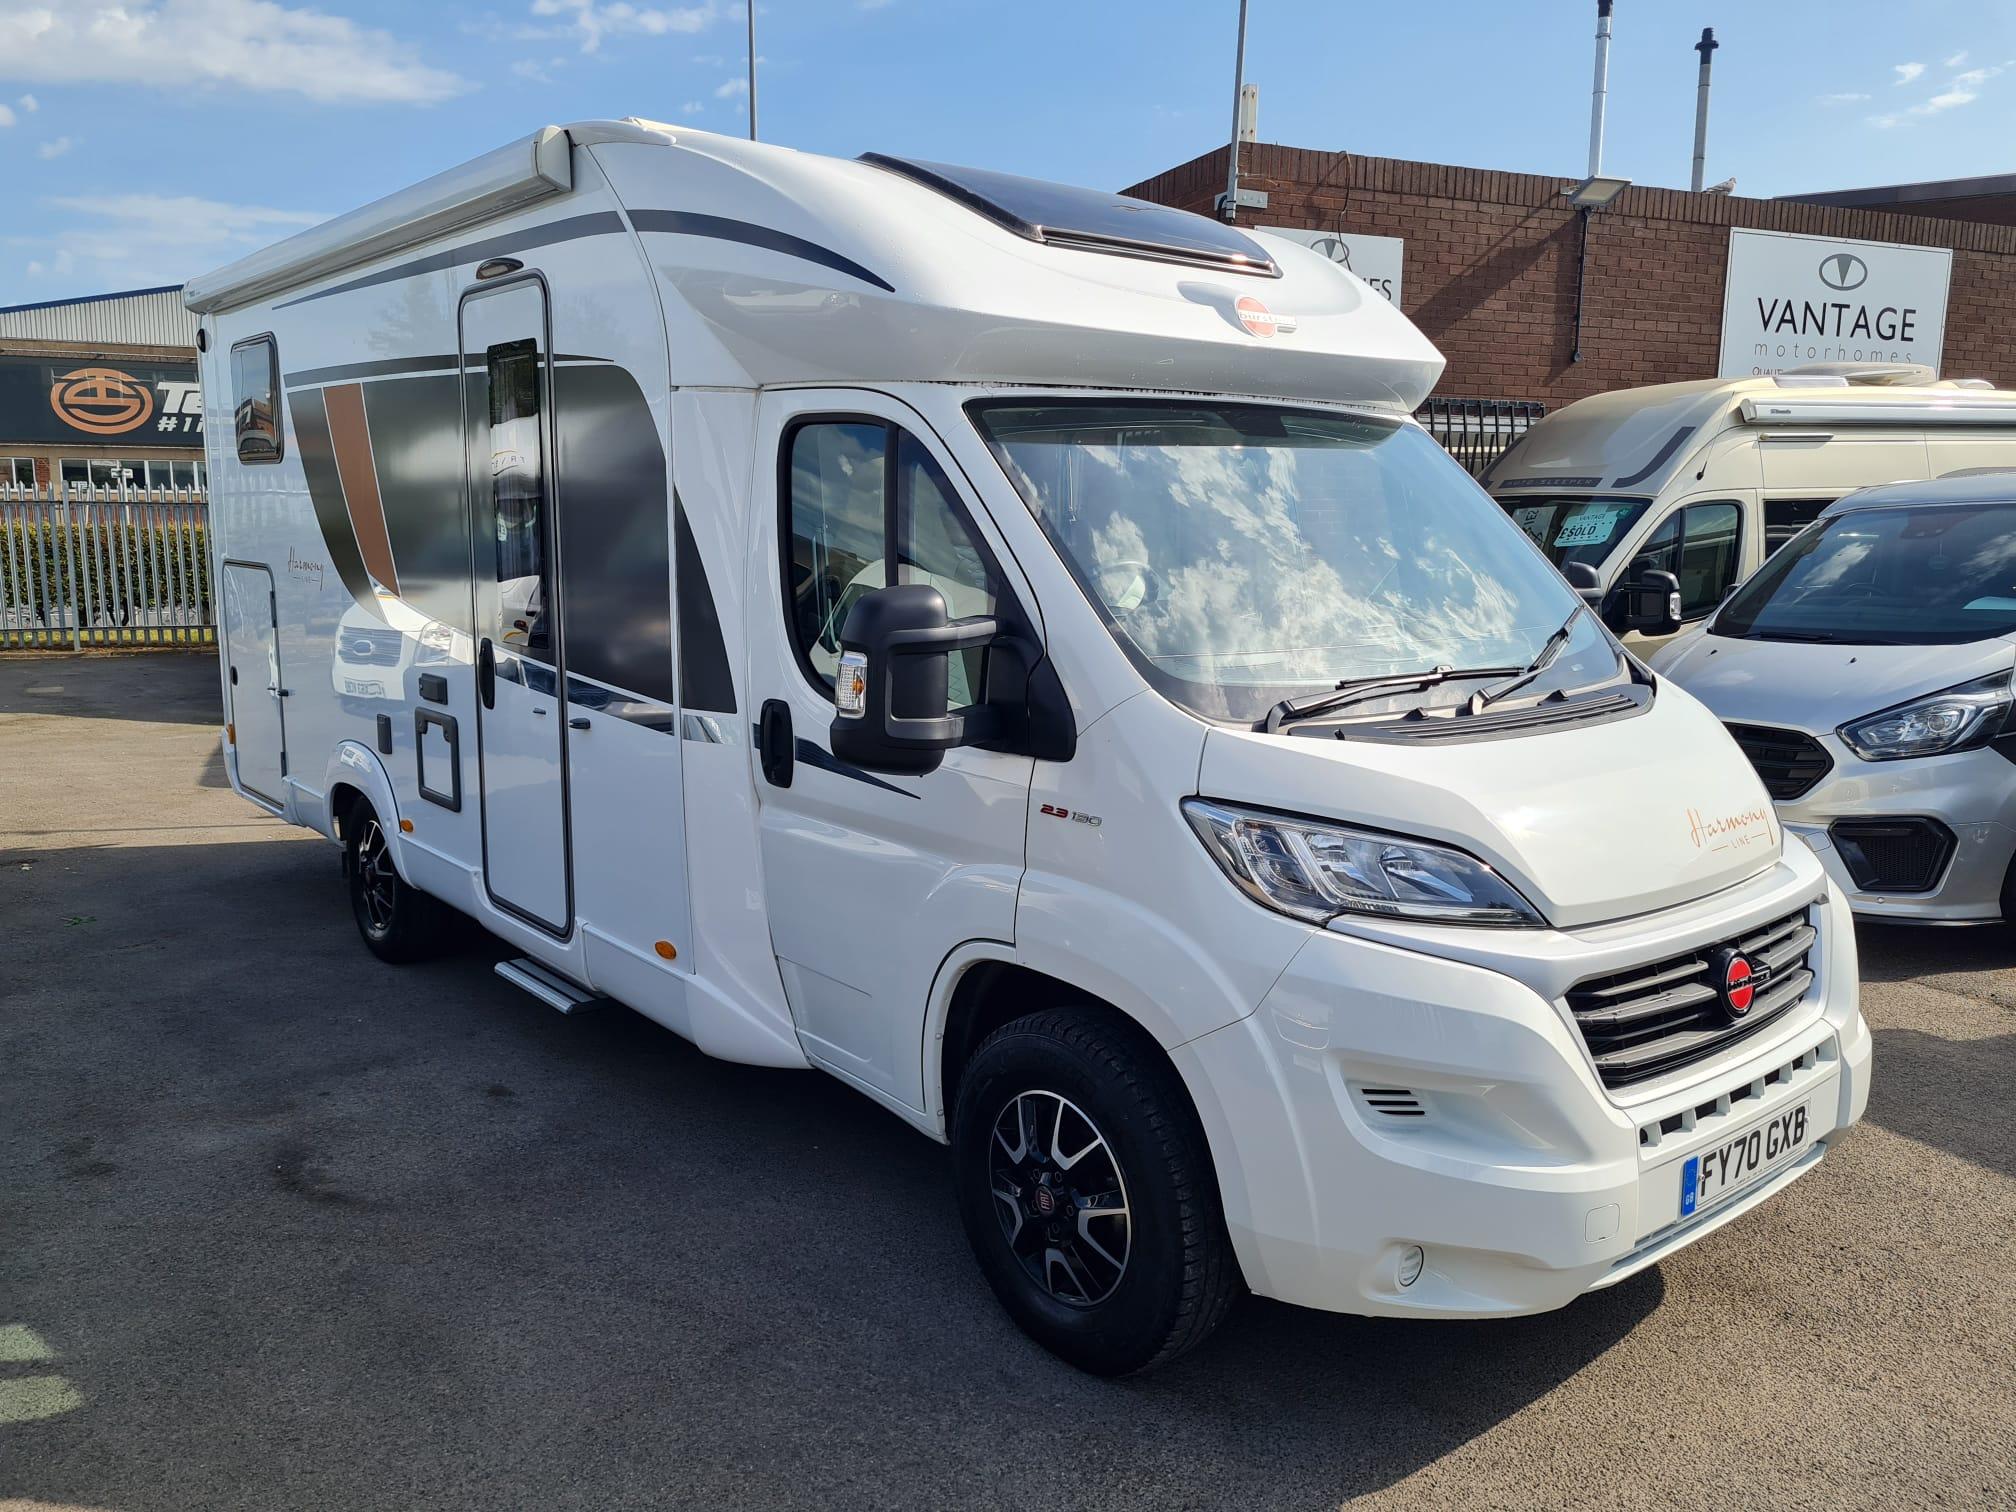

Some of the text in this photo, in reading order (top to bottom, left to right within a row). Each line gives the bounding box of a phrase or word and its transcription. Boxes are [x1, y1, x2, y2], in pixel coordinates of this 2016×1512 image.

[1757, 297, 1917, 342] VANTAGE
[1754, 343, 1912, 363] motorhomes
[157, 416, 193, 432] #1
[1559, 526, 1597, 539] £SOLD
[1686, 808, 1774, 848] Harmony
[1731, 835, 1751, 849] LINE
[1701, 1106, 1806, 1197] FY70 GXB
[1039, 1189, 1051, 1210] FIAT
[1685, 1191, 1694, 1205] GB
